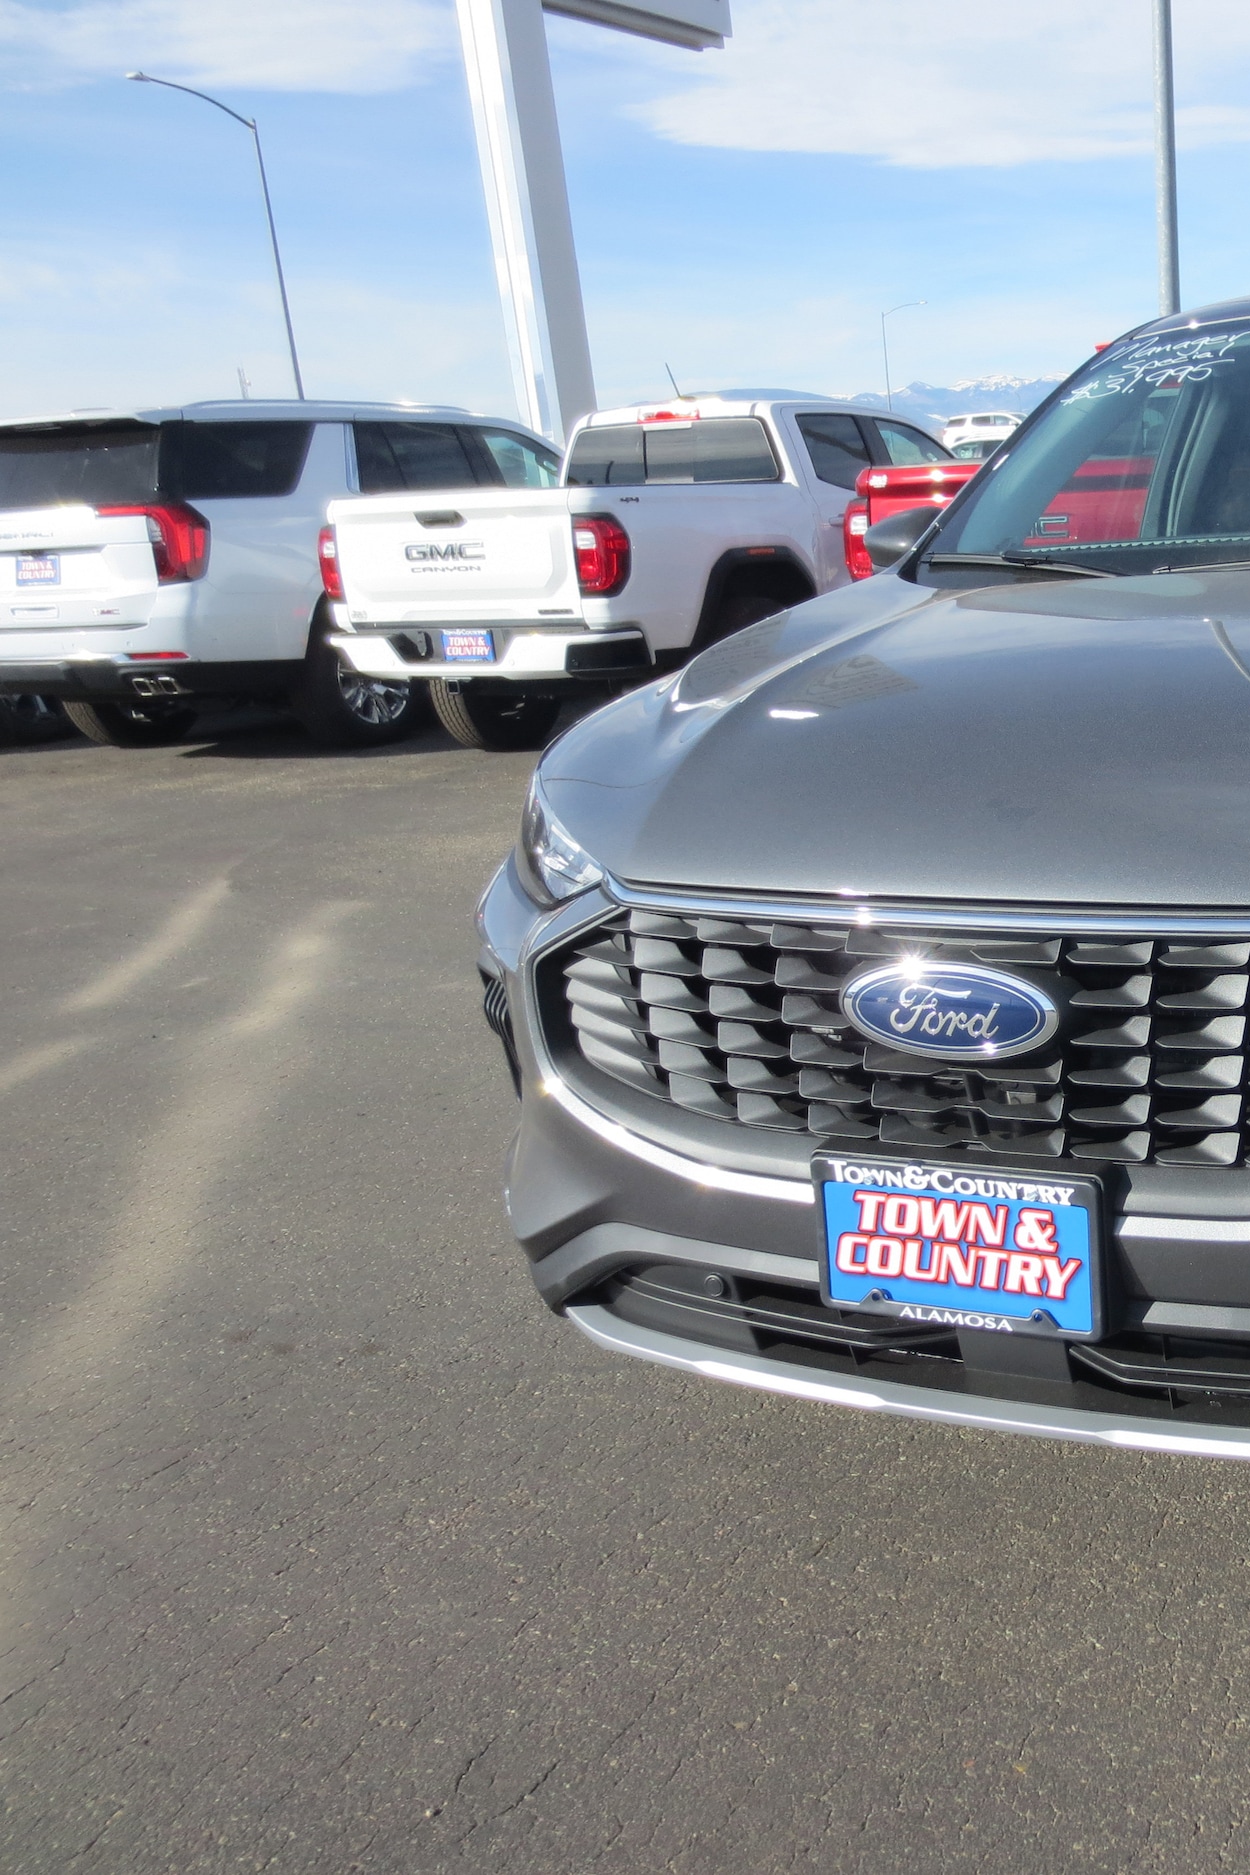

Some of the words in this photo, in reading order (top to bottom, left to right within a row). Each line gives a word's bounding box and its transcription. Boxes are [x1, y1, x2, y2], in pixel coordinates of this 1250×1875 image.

[1060, 359, 1236, 406] $31,995
[404, 543, 486, 561] GMC
[446, 646, 490, 656] COUNTRY
[448, 636, 476, 646] TOWN
[477, 636, 486, 646] &
[889, 982, 1001, 1040] Ford
[853, 1190, 1009, 1247] TOWN
[1014, 1207, 1059, 1254] &
[835, 1232, 1083, 1300] COUNTRY
[899, 1305, 1014, 1333] ALAMOSA
